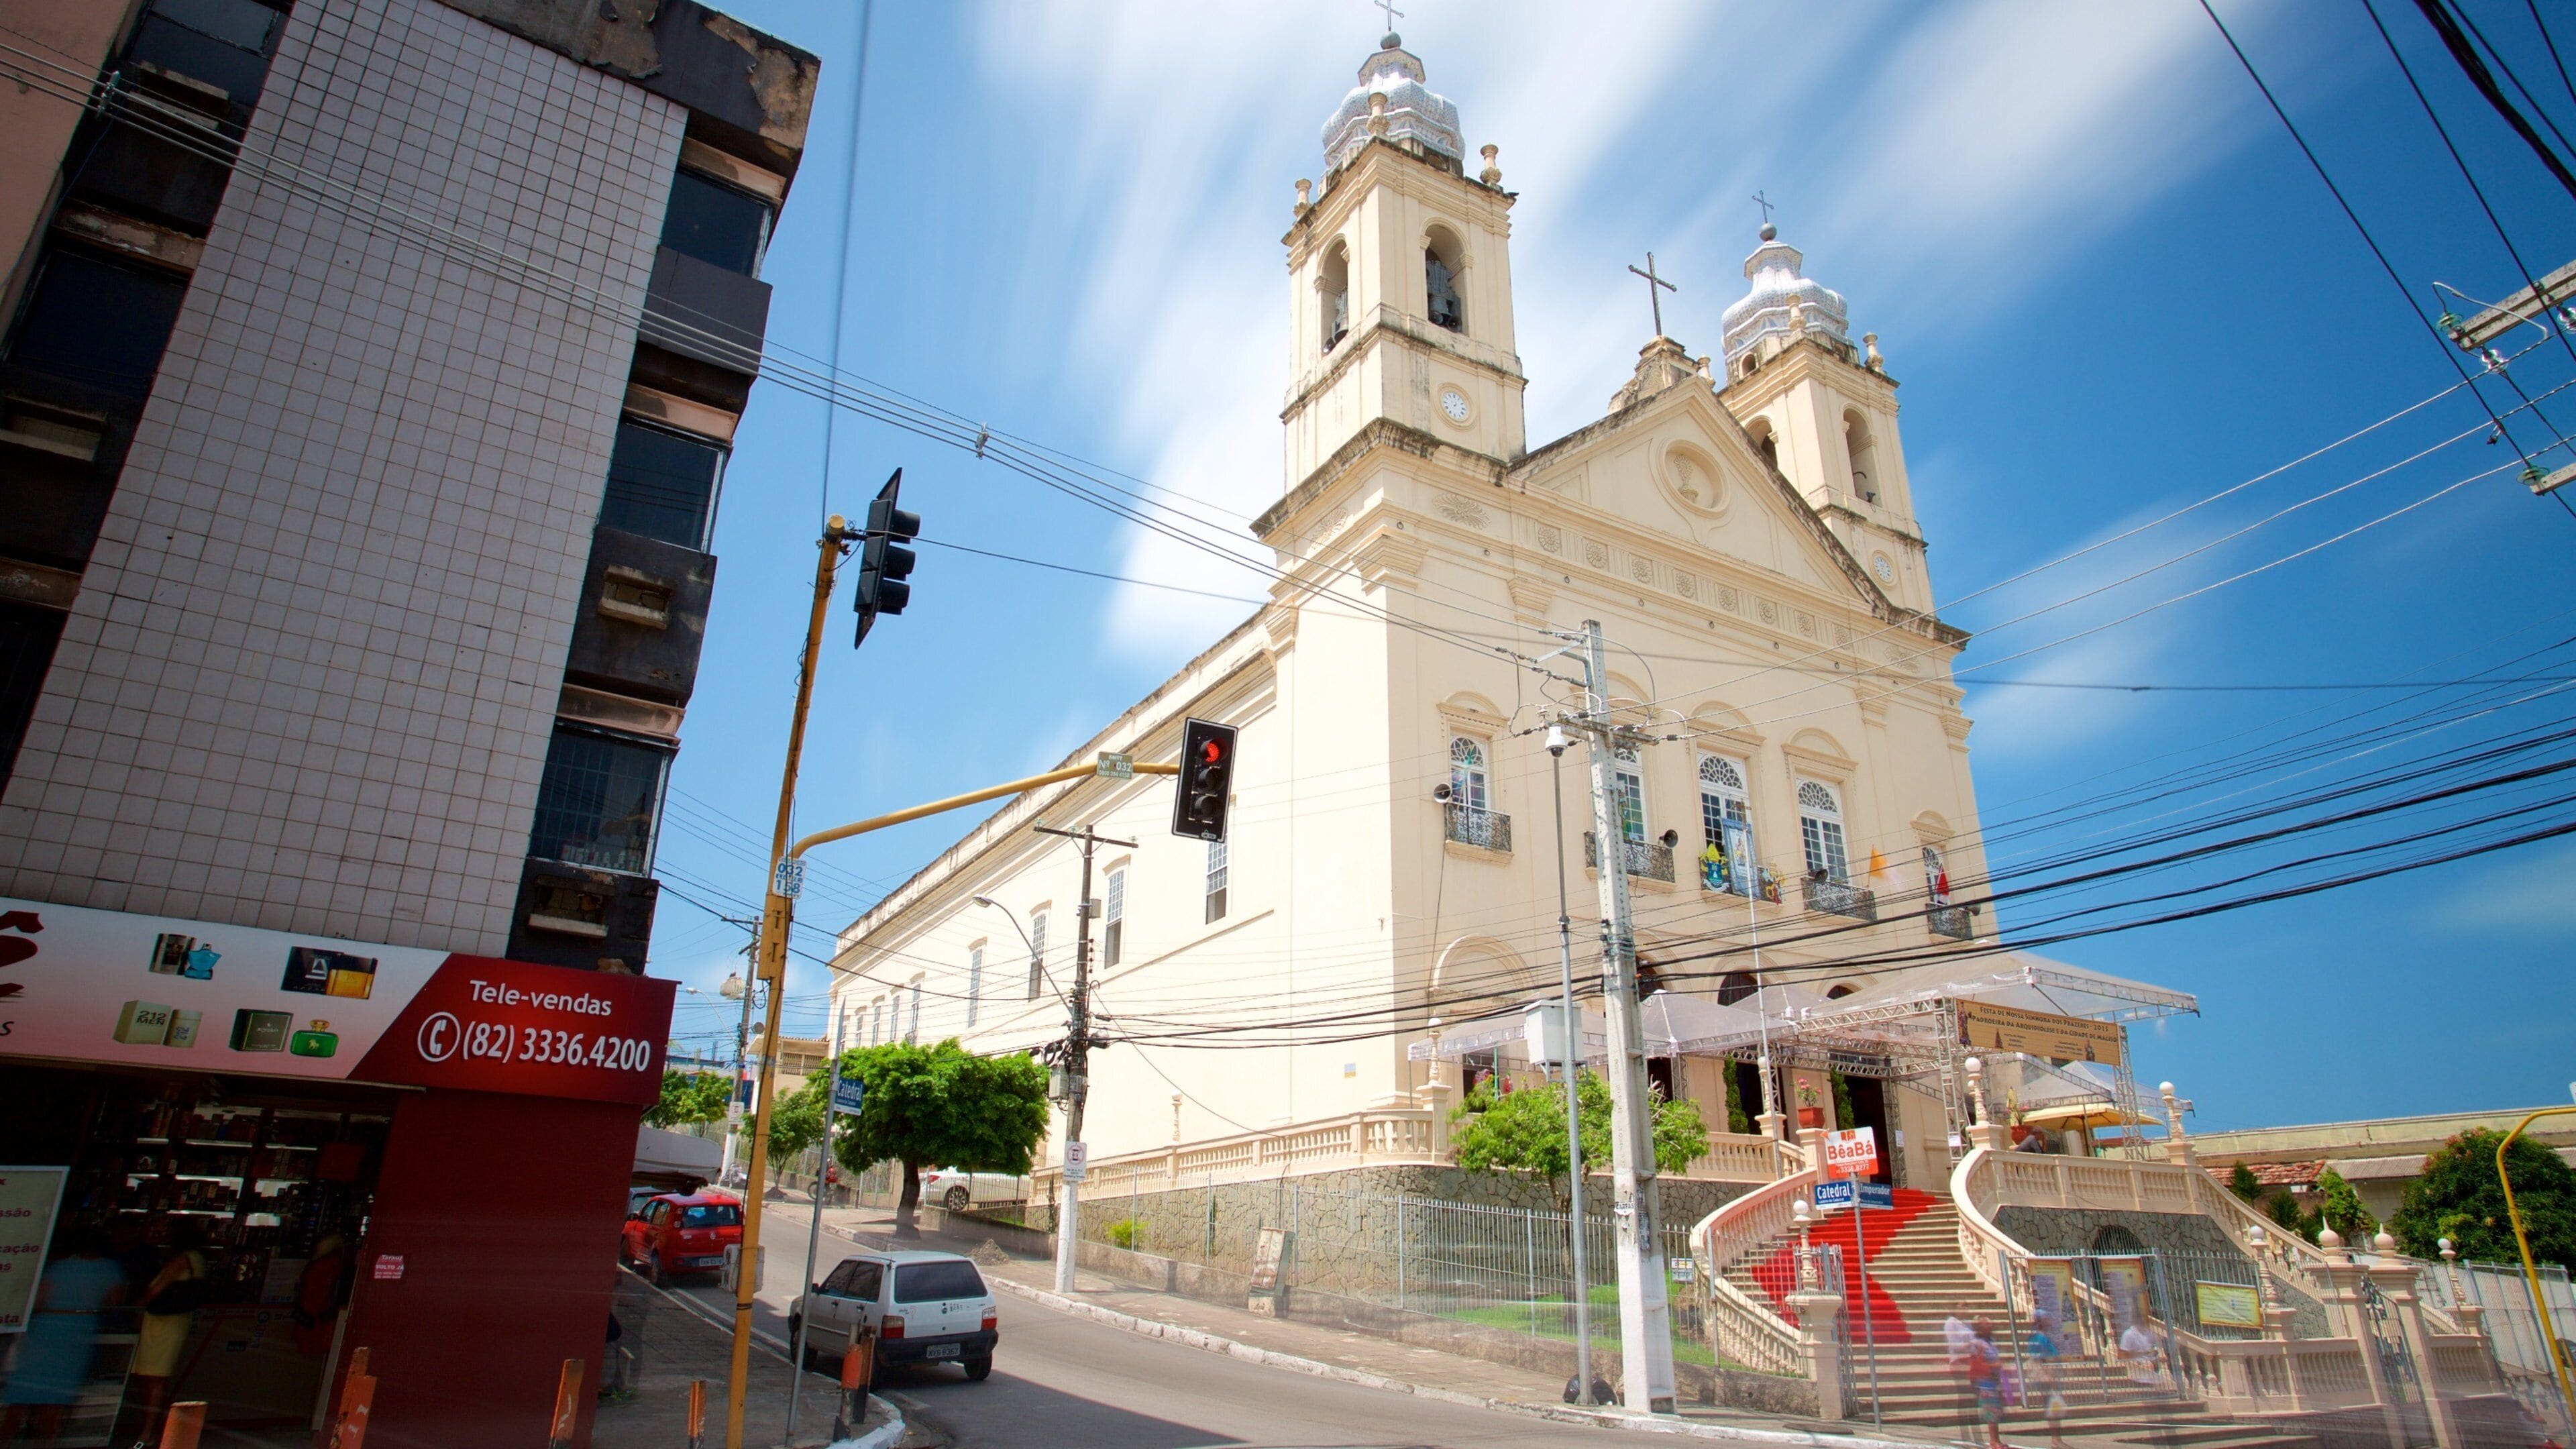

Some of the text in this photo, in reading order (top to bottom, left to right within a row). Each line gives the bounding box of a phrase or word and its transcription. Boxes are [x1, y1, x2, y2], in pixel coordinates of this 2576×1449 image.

[1116, 761, 1132, 773] 032
[778, 863, 804, 877] 032
[470, 979, 612, 1016] Tele-vendas
[136, 1017, 166, 1025] MEN
[140, 1010, 167, 1020] 212
[1972, 1015, 2005, 1026] PADROEIRA
[1980, 1006, 1997, 1015] FESTA
[2006, 1011, 2025, 1019] NOSSA
[2025, 1014, 2051, 1023] SENHORA
[462, 1020, 651, 1073] (82) 3336.4200
[837, 1079, 863, 1102] Catedral
[1827, 1140, 1874, 1160] BêaBá
[1817, 1182, 1851, 1199] Catedral
[1860, 1183, 1890, 1195] Imperador
